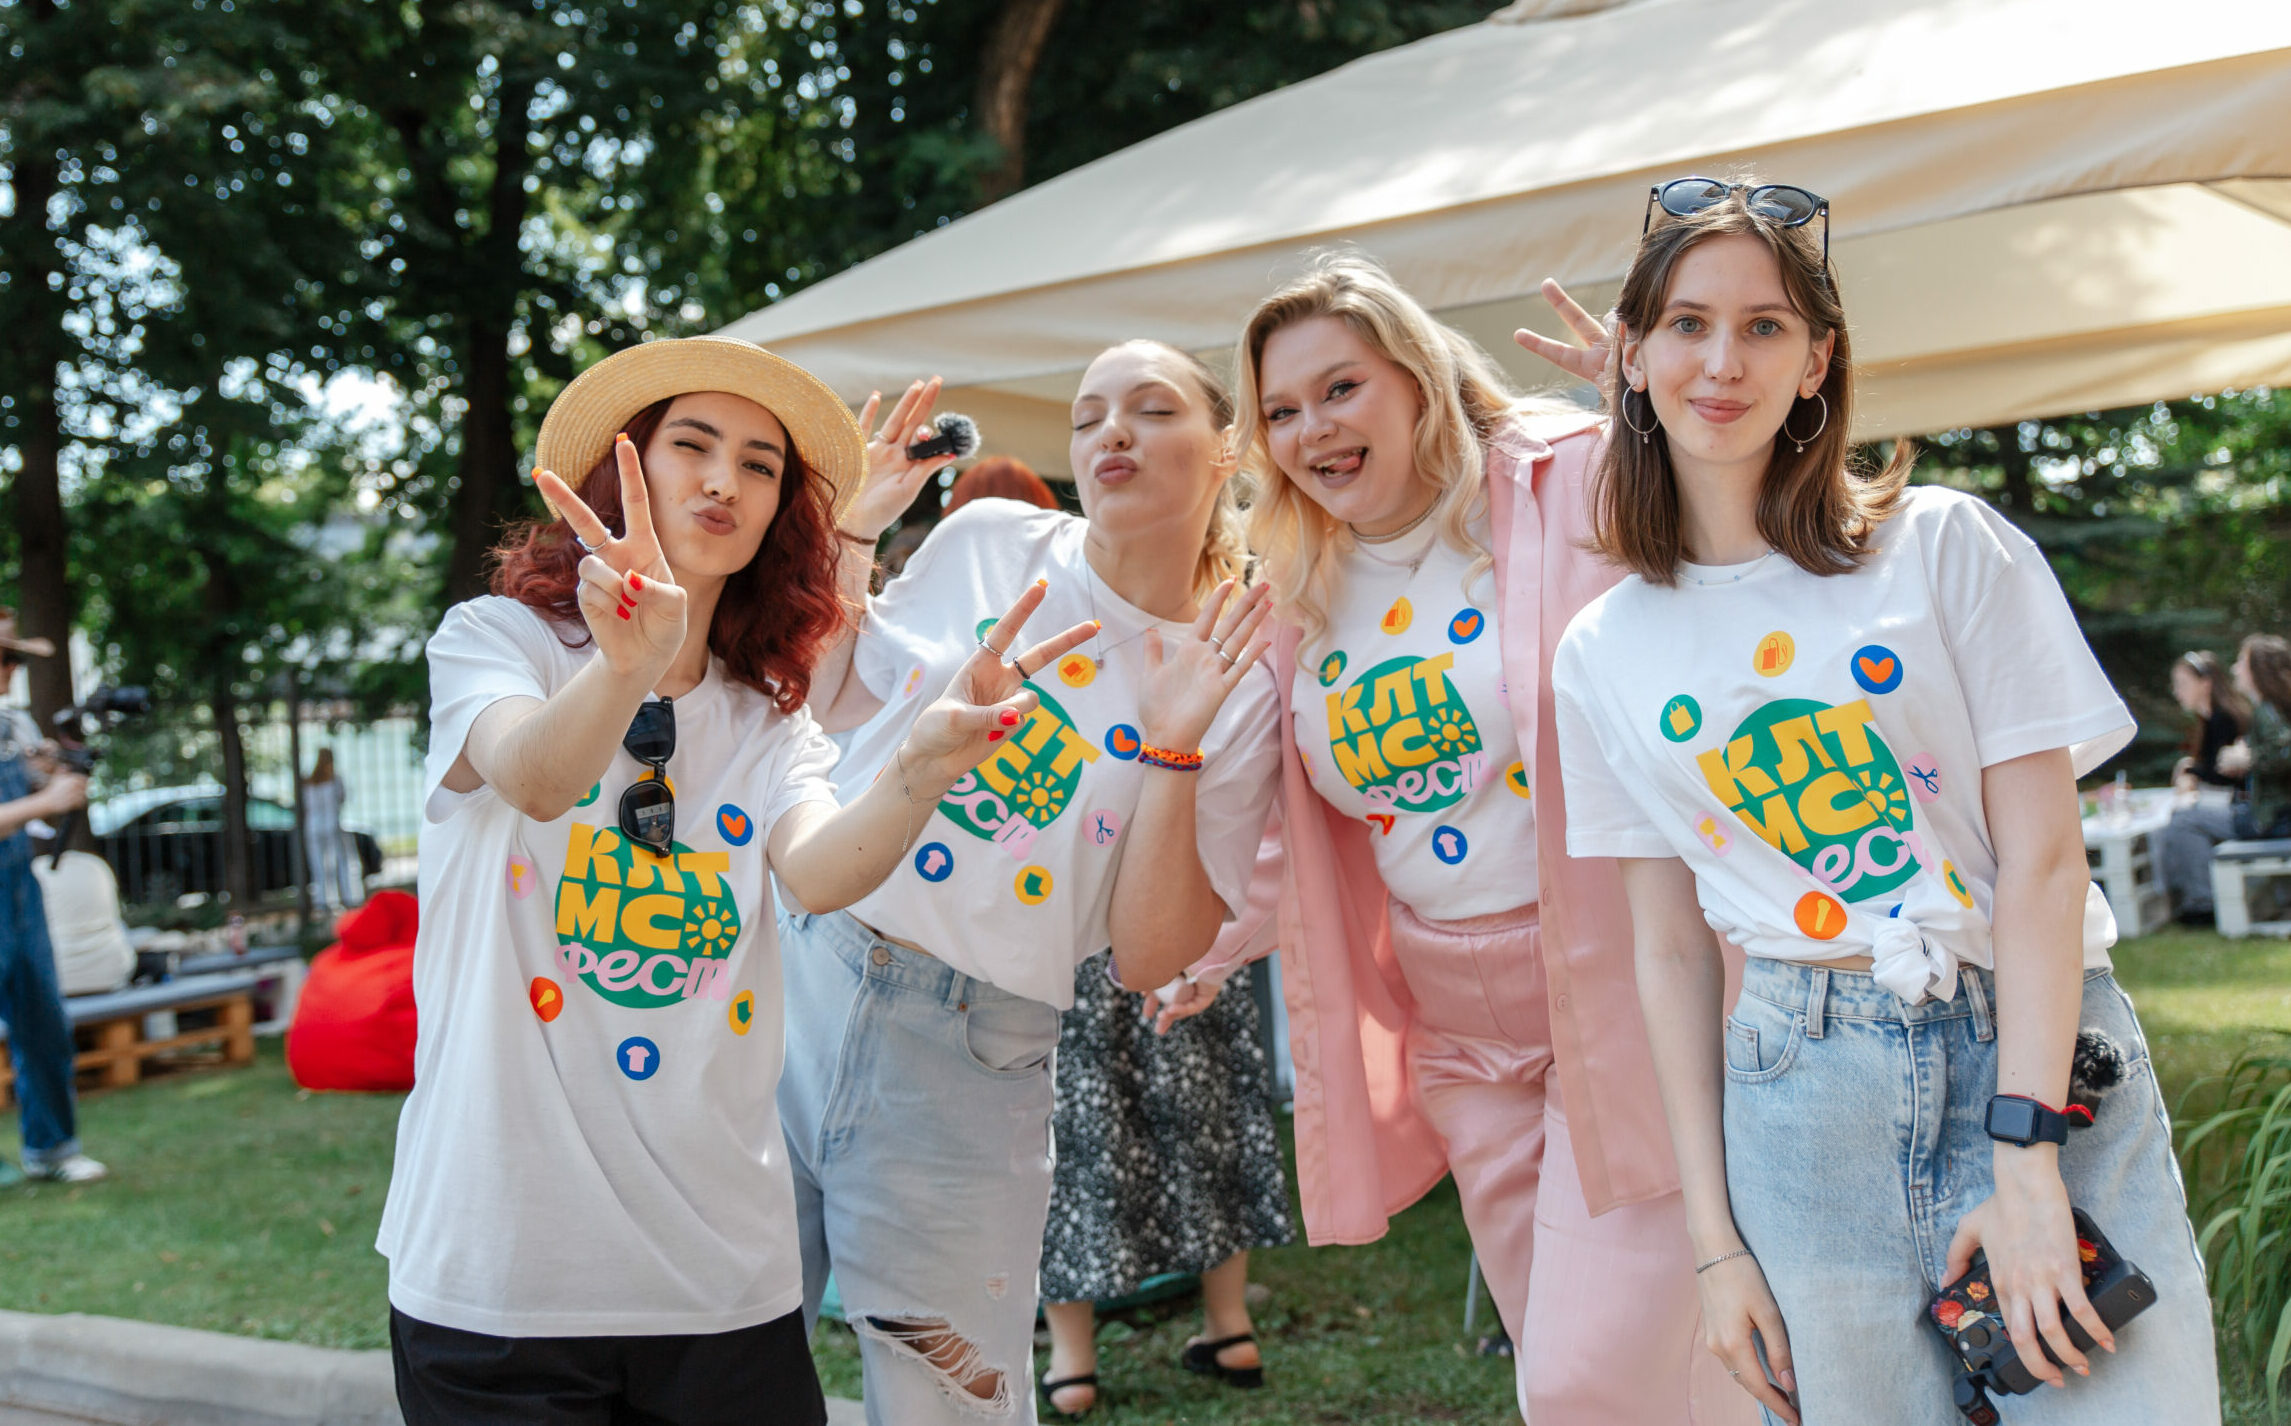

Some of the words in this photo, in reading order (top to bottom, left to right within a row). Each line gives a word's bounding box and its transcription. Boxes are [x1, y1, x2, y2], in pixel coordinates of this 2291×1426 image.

[1326, 651, 1454, 741] КЛТ
[1331, 717, 1440, 788] МС
[1695, 698, 1876, 808] КЛТ
[1734, 770, 1879, 855] МС
[563, 822, 730, 898] КЛТ
[555, 881, 686, 950] МС
